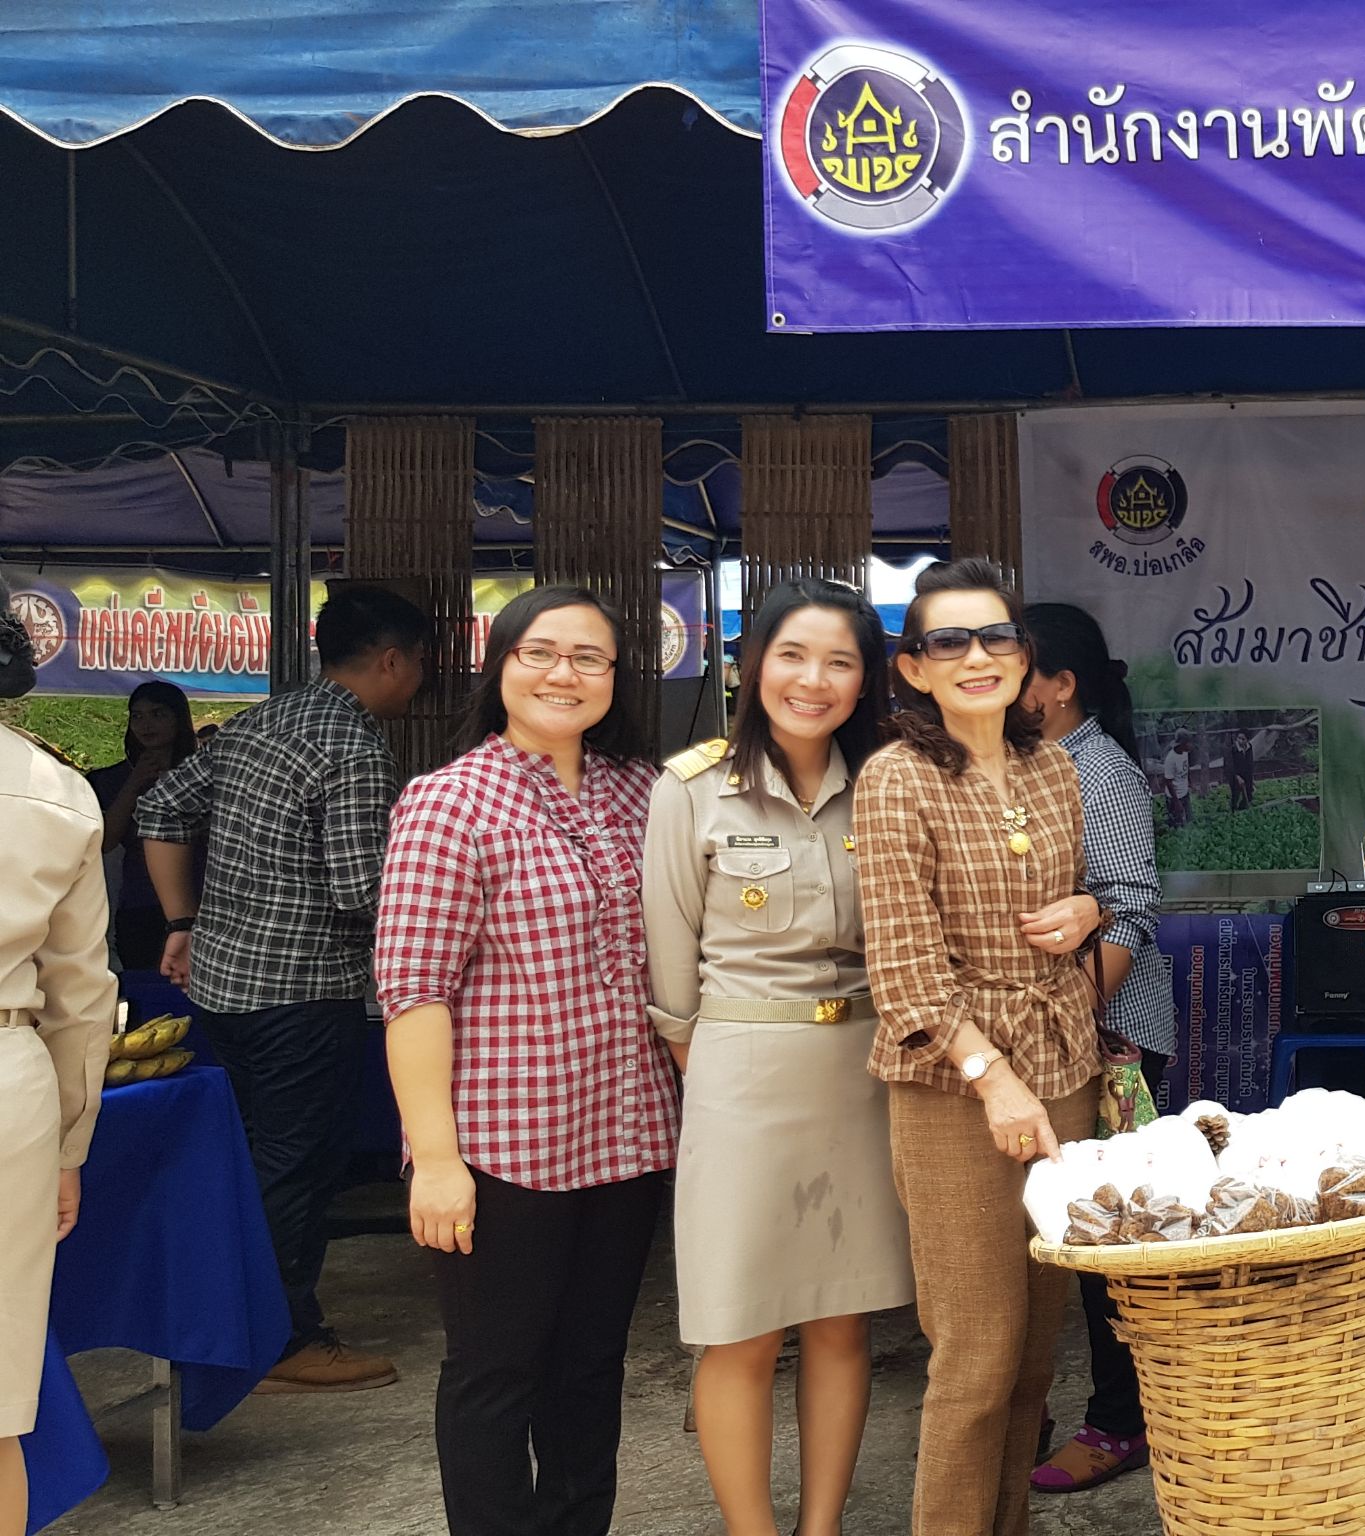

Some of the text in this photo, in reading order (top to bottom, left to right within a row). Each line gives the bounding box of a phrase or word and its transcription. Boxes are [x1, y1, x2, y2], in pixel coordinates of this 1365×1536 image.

[1089, 537, 1206, 577] สพอ.บ่อเกลือ
